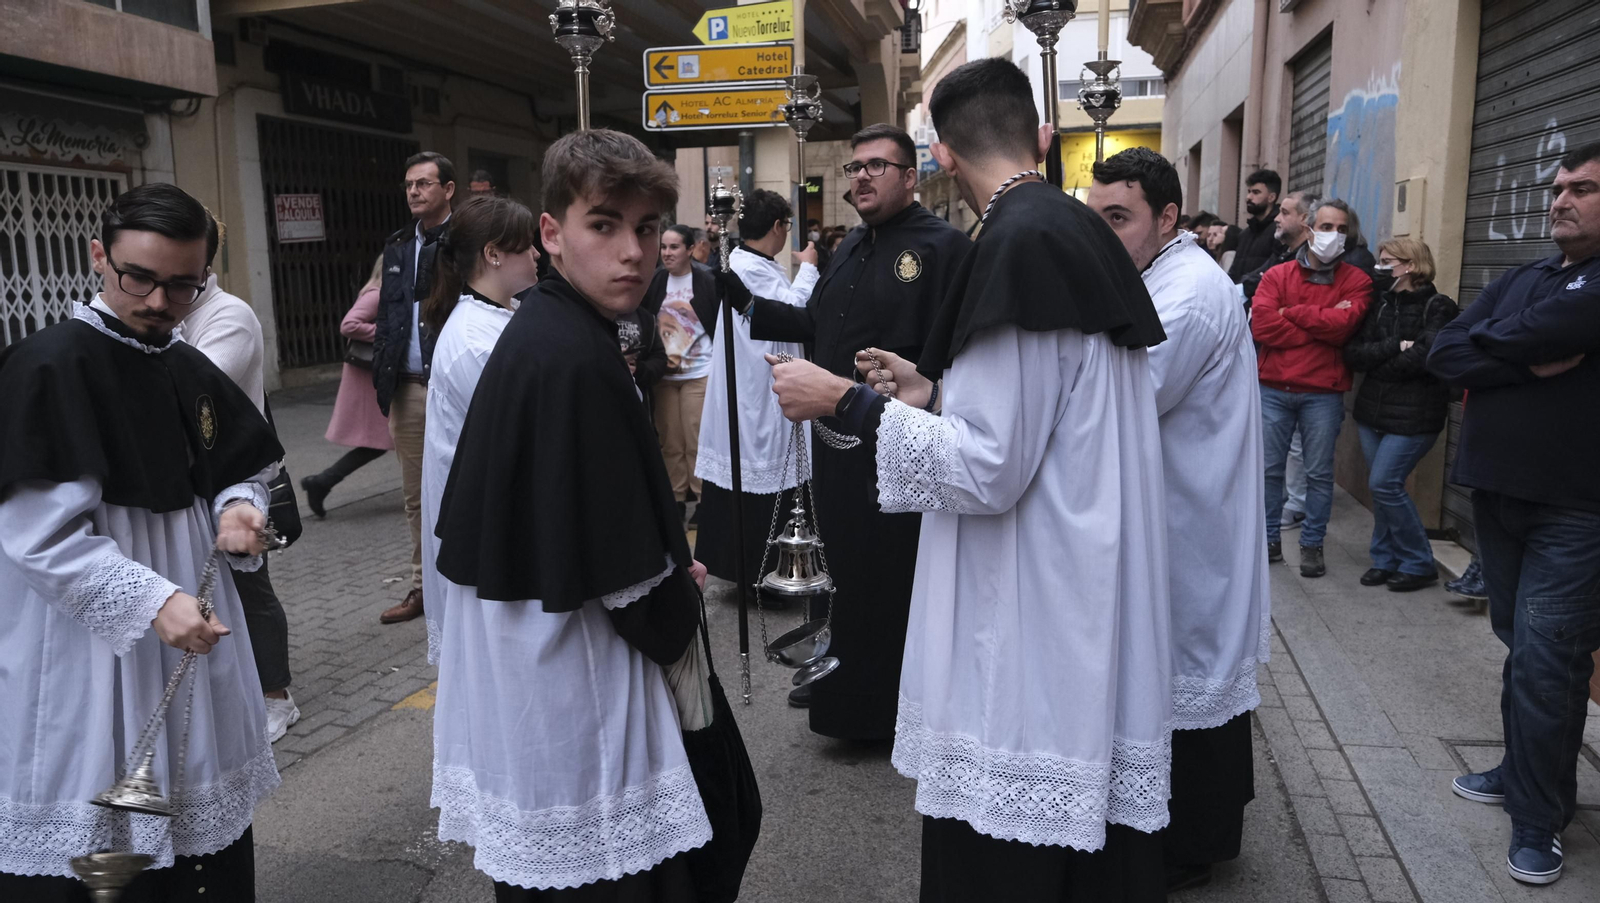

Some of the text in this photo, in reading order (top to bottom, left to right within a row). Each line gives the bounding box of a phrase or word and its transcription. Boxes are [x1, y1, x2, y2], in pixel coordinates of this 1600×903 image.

[736, 11, 760, 19] HOTEL
[710, 18, 725, 40] P
[757, 51, 788, 62] Hotel
[737, 64, 789, 76] Catedral
[301, 80, 377, 118] VHADA
[712, 96, 732, 106] AC
[680, 112, 704, 120] Hotel
[40, 122, 121, 160] Memoria
[282, 197, 320, 209] VENDE
[284, 208, 321, 221] ALQUILA
